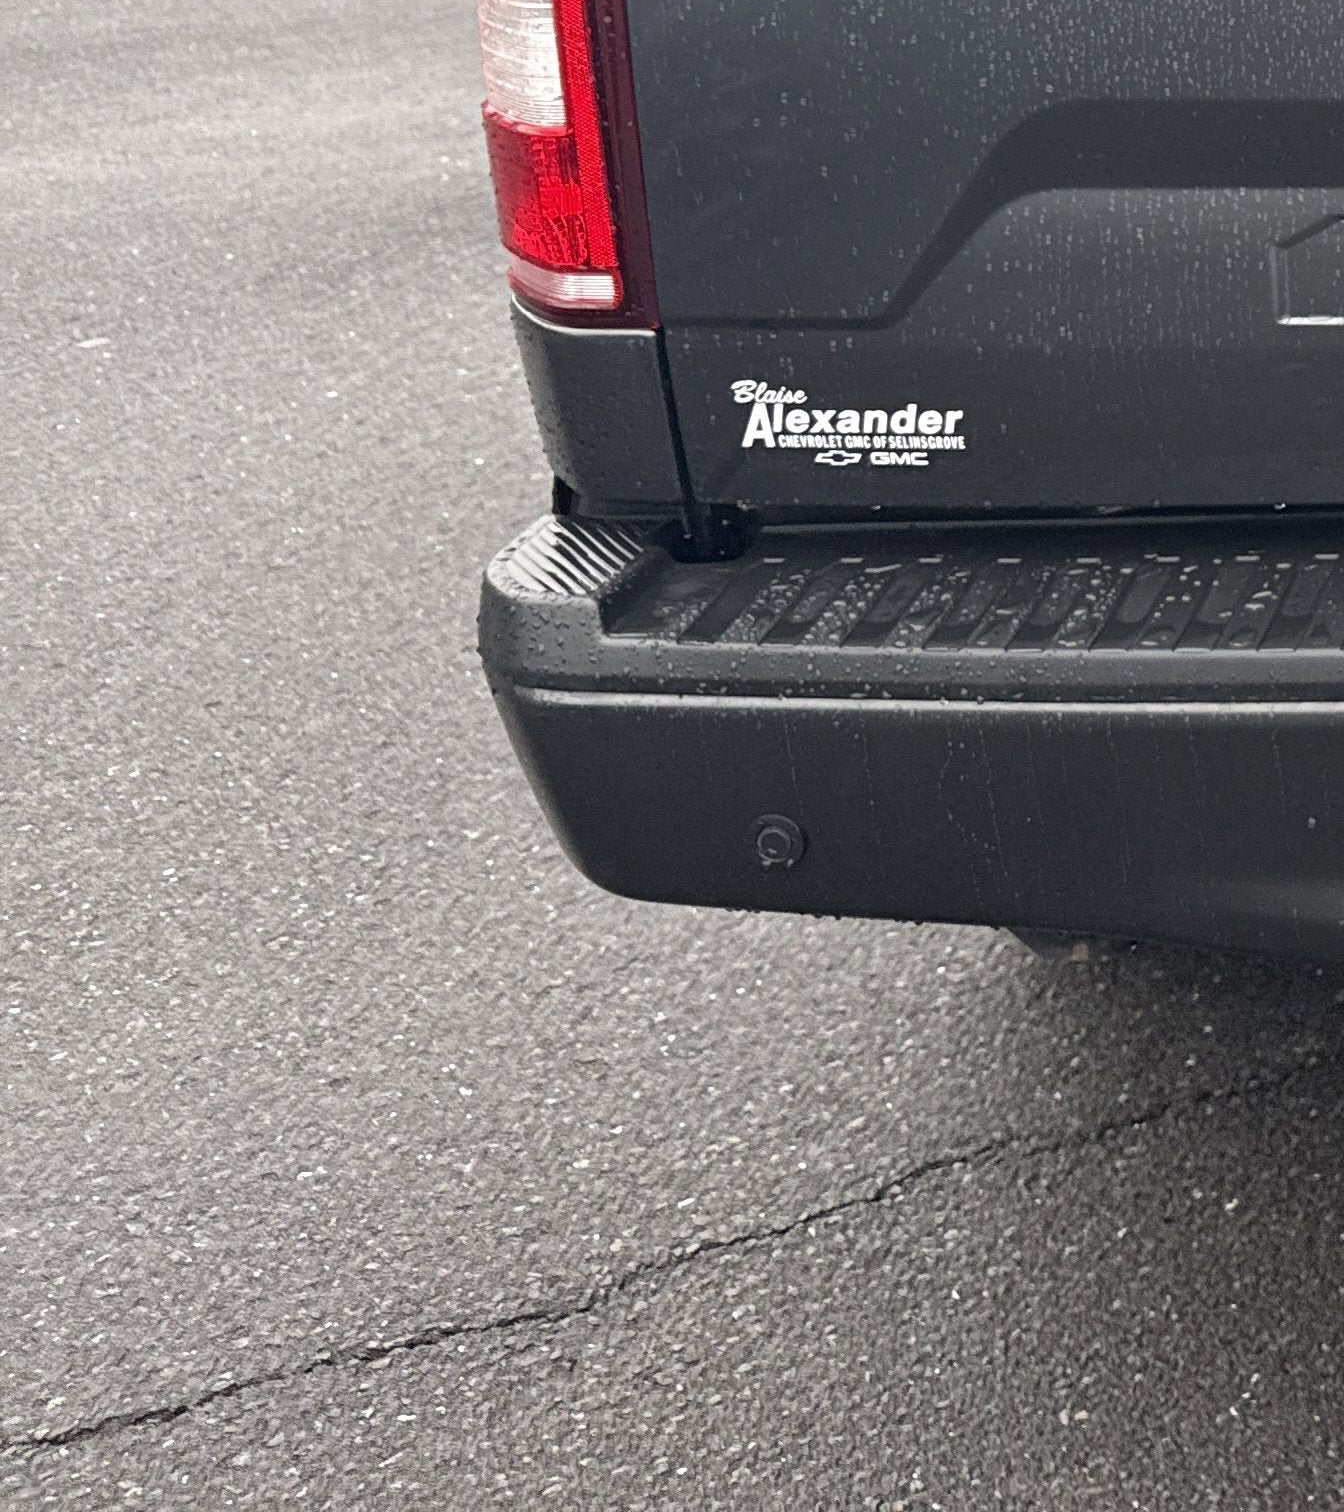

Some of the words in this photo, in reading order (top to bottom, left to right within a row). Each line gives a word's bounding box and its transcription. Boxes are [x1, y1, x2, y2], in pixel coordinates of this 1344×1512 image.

[731, 380, 808, 404] Blaise
[741, 402, 964, 448] Alexander
[778, 435, 842, 448] CHEVROLET
[845, 435, 872, 449] GMC
[874, 435, 888, 449] OF
[889, 435, 966, 450] SELINSGROVE
[870, 451, 929, 466] GMC
